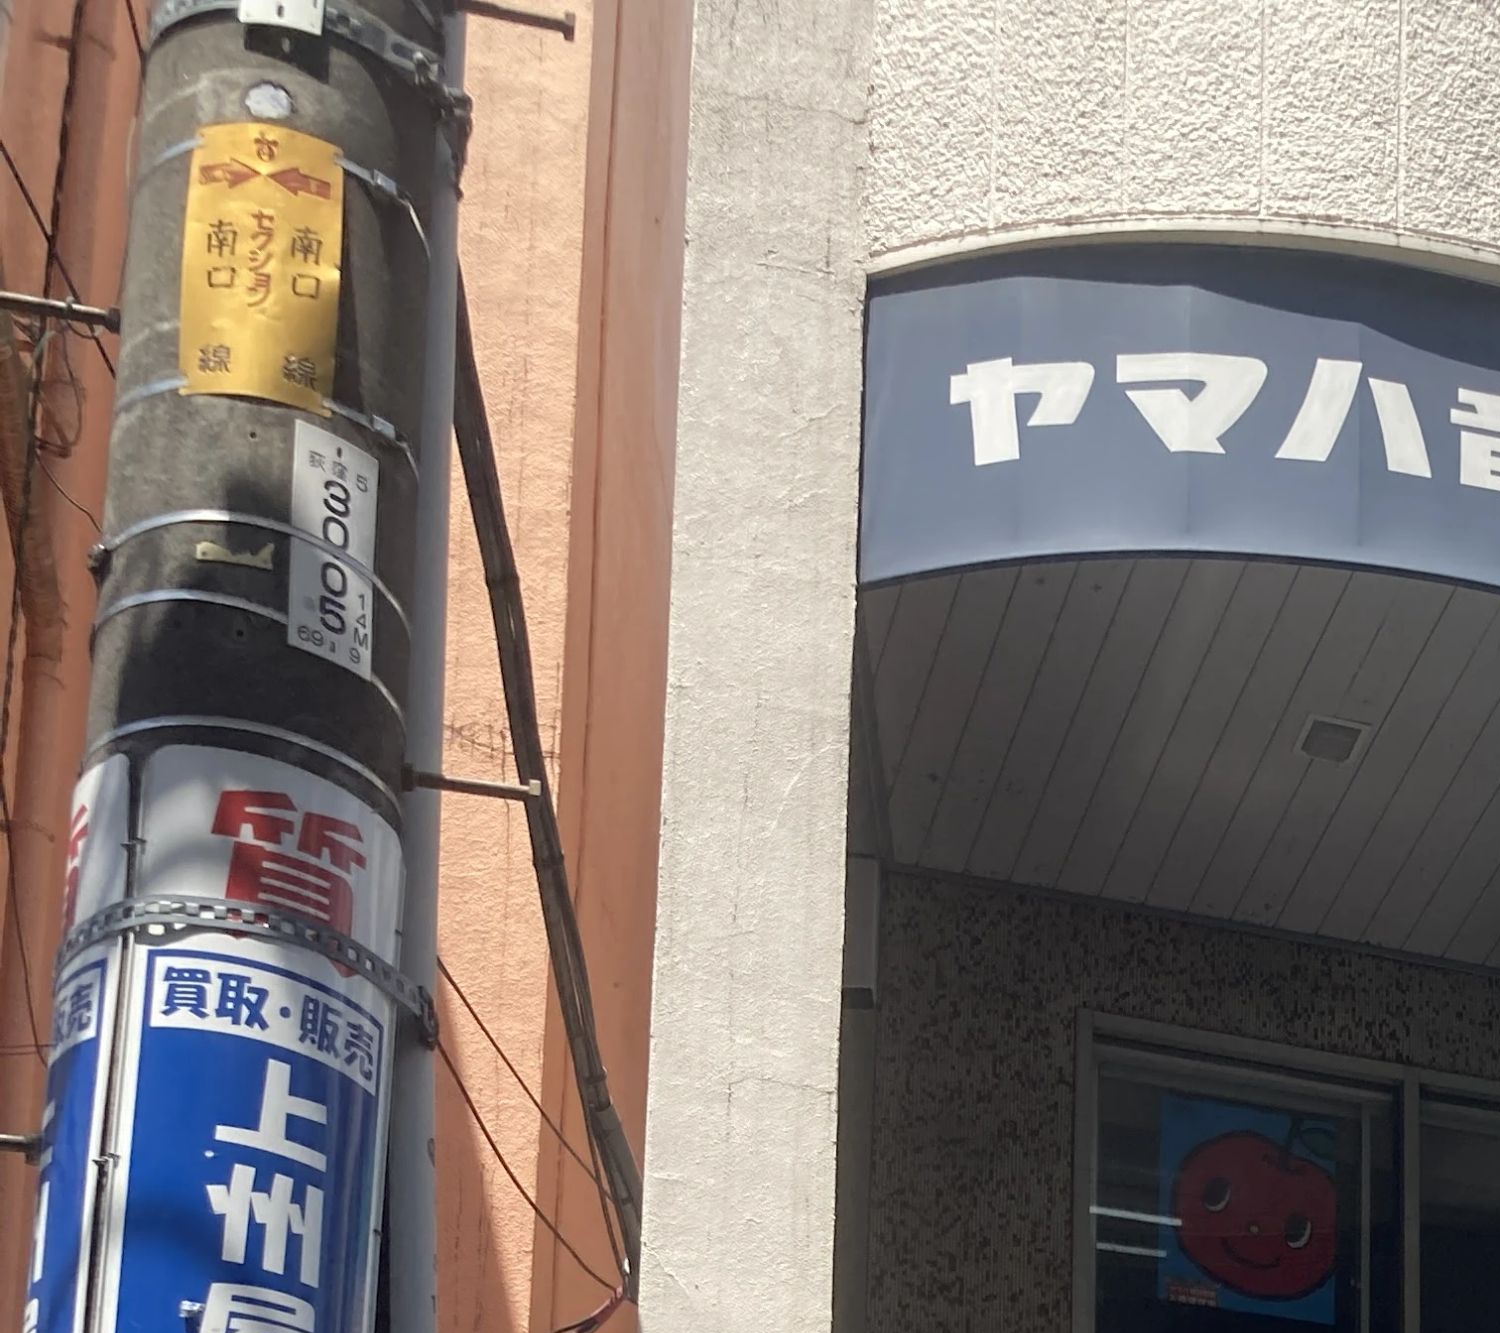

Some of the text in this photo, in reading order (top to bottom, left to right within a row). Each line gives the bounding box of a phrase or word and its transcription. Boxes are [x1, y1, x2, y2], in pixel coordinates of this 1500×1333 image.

[207, 219, 237, 288] 南口
[291, 227, 322, 299] 南口
[211, 790, 367, 978] 質
[160, 965, 375, 1084] 買取・販売
